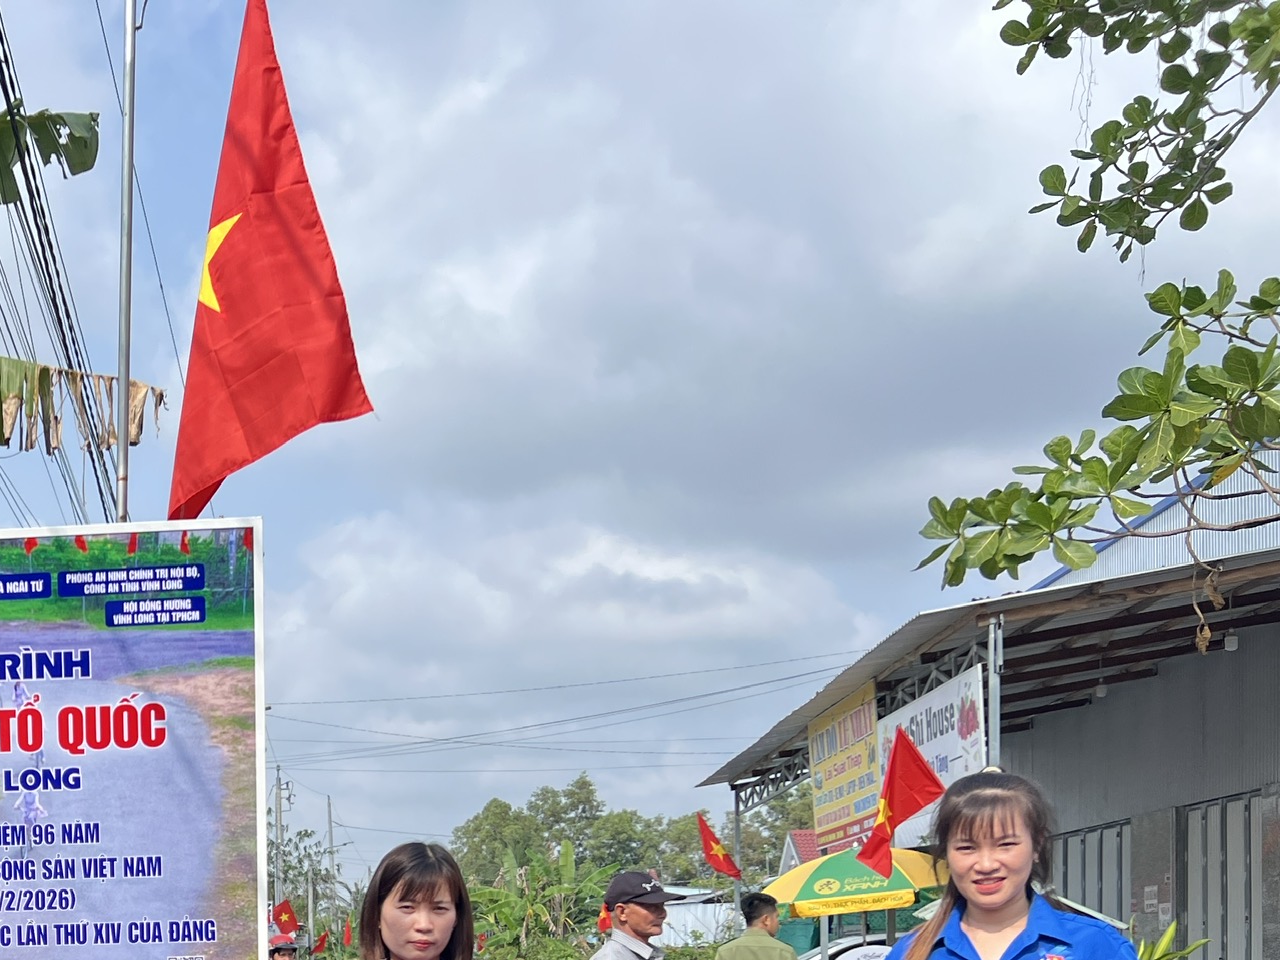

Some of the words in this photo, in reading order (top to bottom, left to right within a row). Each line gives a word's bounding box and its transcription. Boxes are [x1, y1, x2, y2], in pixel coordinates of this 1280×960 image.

[65, 572, 93, 584] PHÒNG
[94, 571, 106, 582] AN
[108, 570, 127, 581] NINH
[128, 567, 154, 580] CHÍNH
[155, 567, 169, 581] TRỊ
[170, 566, 185, 580] NỘI
[83, 582, 106, 595] CÔNG
[107, 581, 120, 593] AN
[120, 580, 140, 593] TỈNH
[140, 579, 161, 592] VĨNH
[161, 578, 183, 590] LONG
[112, 612, 133, 625] VĨNH
[133, 612, 155, 624] LONG
[156, 611, 171, 625] TẠI
[171, 610, 201, 623] TPHCM
[122, 600, 138, 615] HỘI
[139, 599, 162, 612] ĐỒNG
[57, 693, 167, 755] QUỐC
[925, 702, 956, 743] House
[4, 768, 82, 792] LONG
[33, 823, 55, 845] 96
[61, 820, 100, 844] NĂM
[41, 854, 76, 880] SẢN
[81, 854, 118, 882] VIỆT
[123, 855, 162, 878] NAM
[841, 880, 889, 892] XANH
[18, 919, 48, 946] LẦN
[53, 921, 90, 945] THỨ
[93, 922, 122, 945] XIV
[127, 916, 163, 943] CỦA
[168, 915, 217, 942] ĐẢNG
